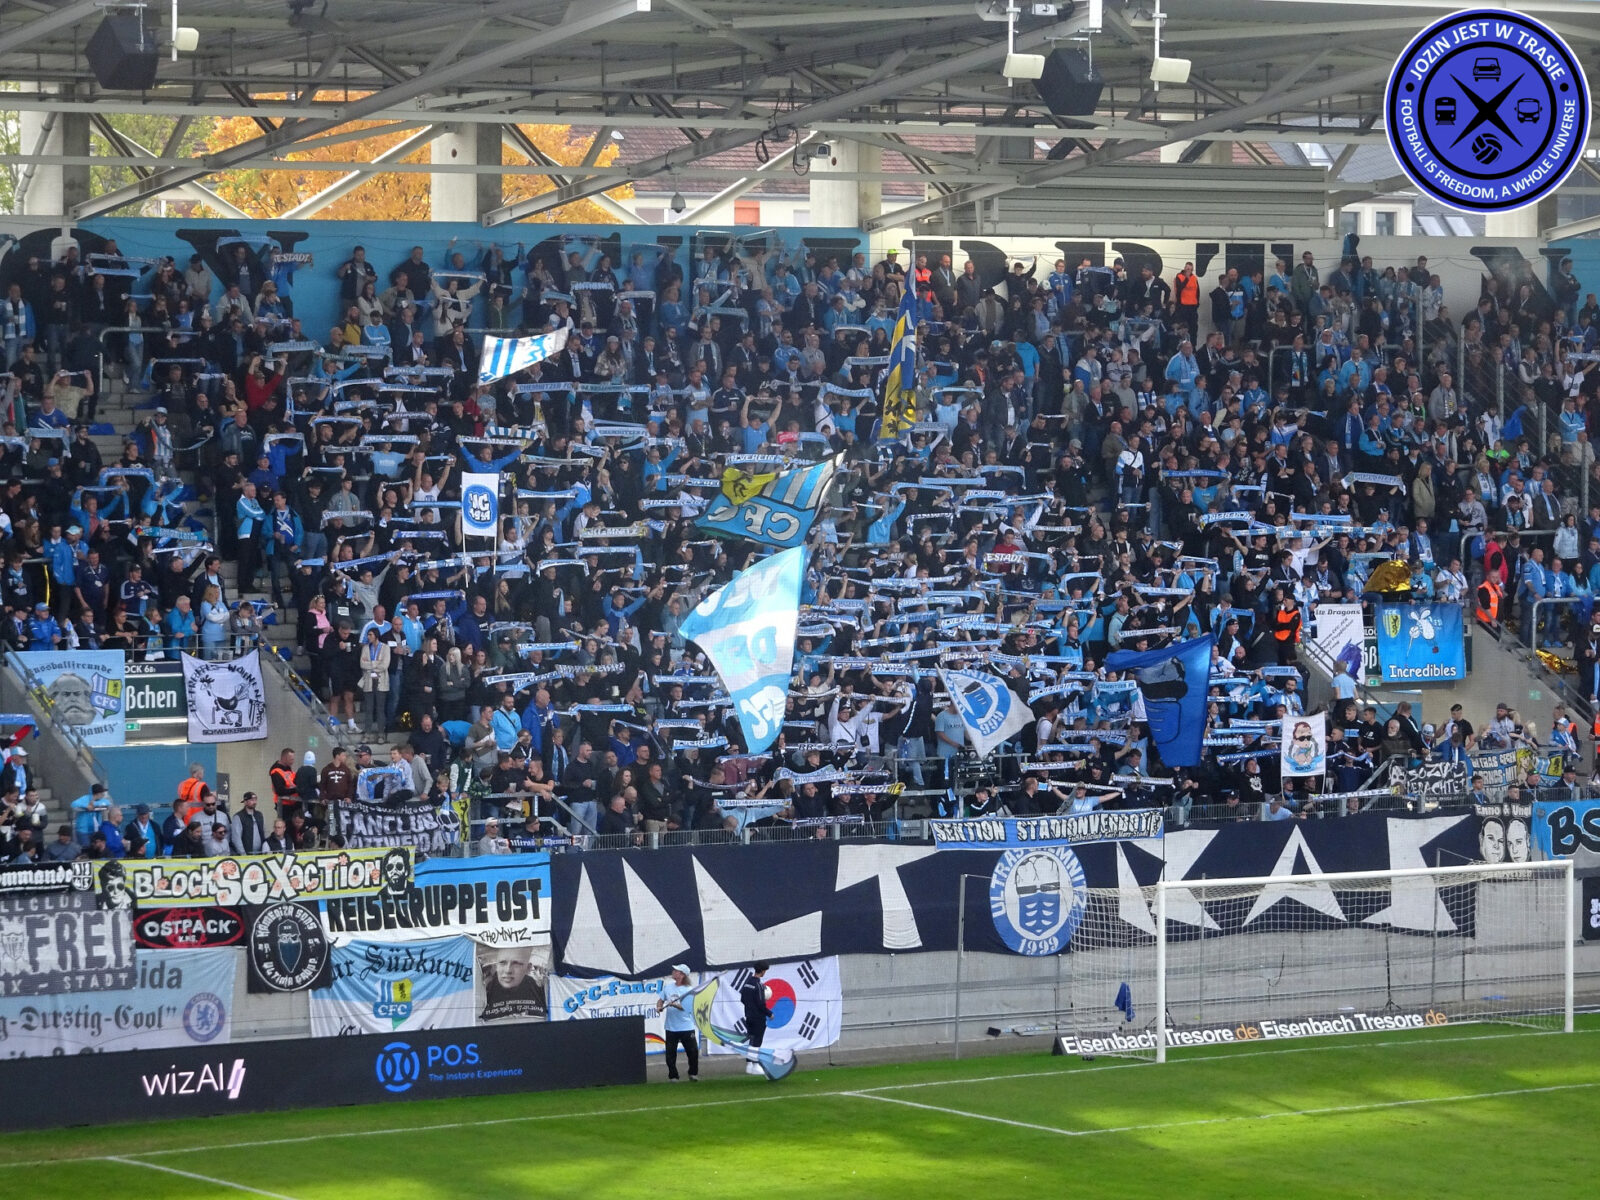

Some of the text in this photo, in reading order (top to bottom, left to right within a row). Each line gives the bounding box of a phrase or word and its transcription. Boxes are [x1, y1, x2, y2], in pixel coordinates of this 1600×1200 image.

[1389, 663, 1457, 679] Incredibles
[94, 694, 118, 709] CFC
[125, 684, 178, 712] ßchen
[338, 809, 439, 837] FANCLUB
[934, 820, 1006, 843] SEKTION
[990, 848, 1025, 918] ULTRAS
[326, 878, 542, 933] REISEGRUPPE OST
[144, 919, 232, 937] OSTPACK
[26, 911, 125, 974] FREI
[1017, 936, 1060, 955] 1999
[359, 944, 473, 983] Südkurve
[63, 972, 129, 990] STADT
[563, 980, 665, 1014] CFC-Fancl
[377, 1002, 408, 1016] CFC
[429, 1066, 523, 1081] The Instore Experience
